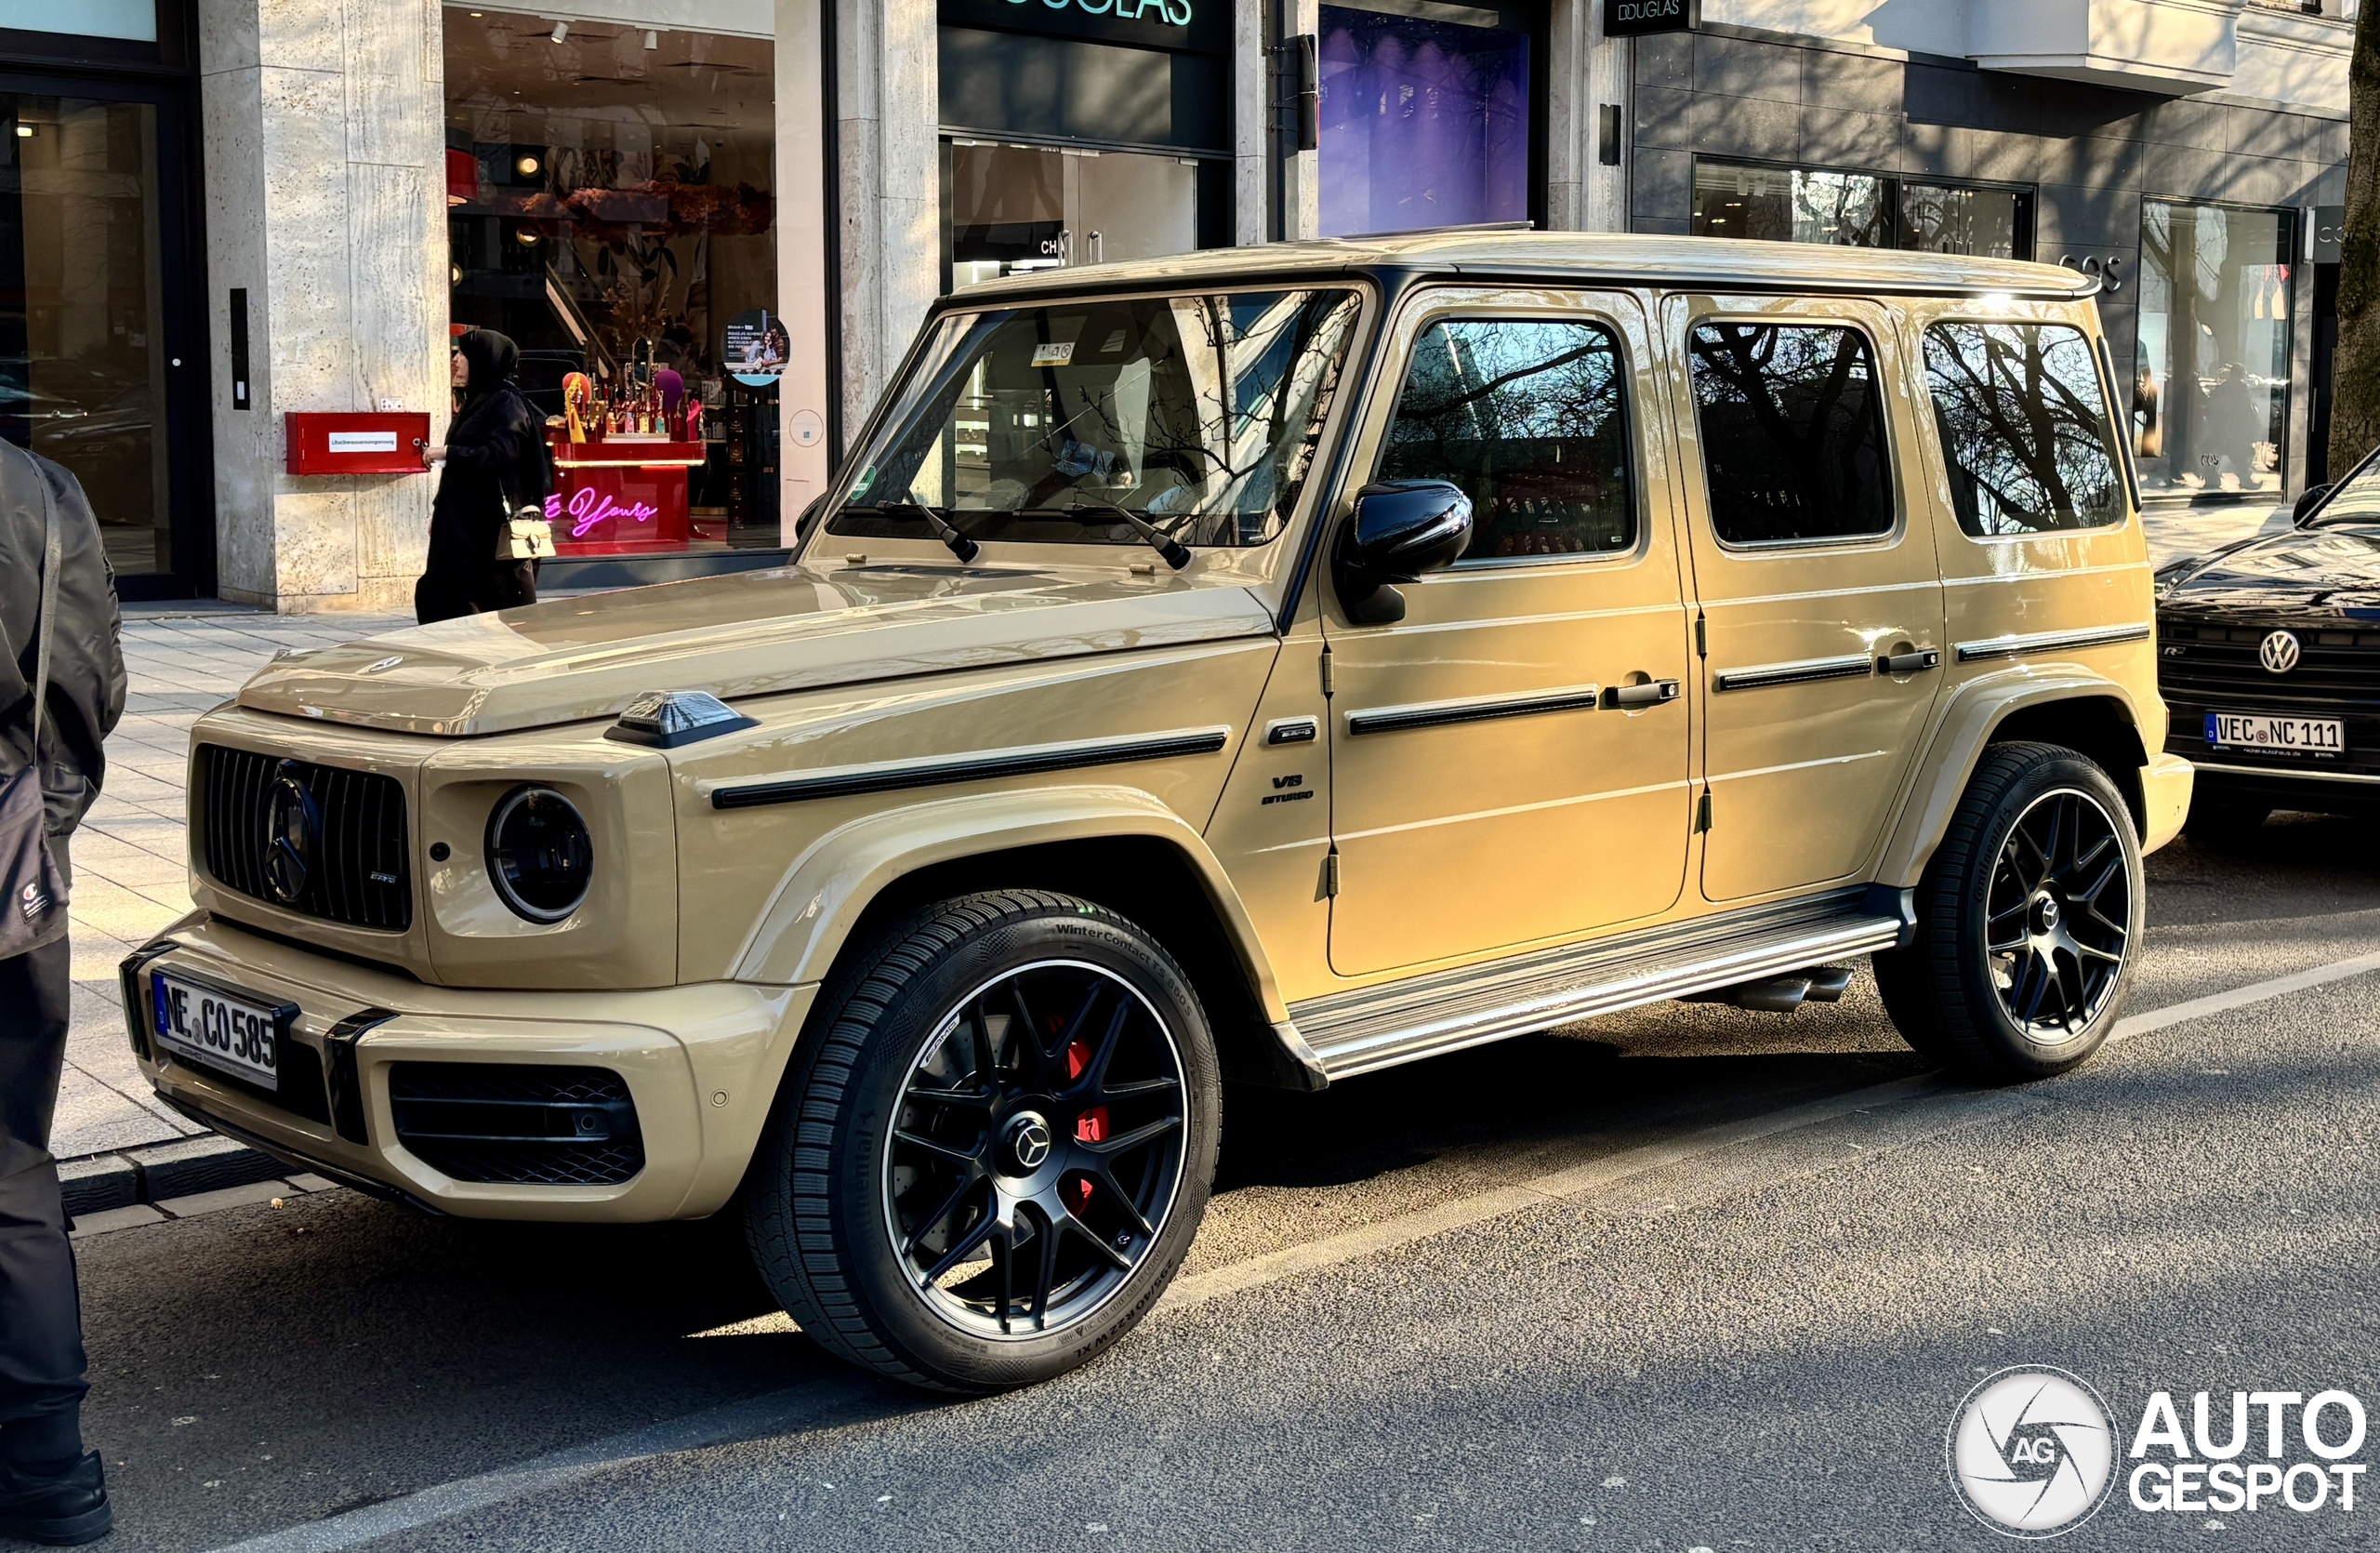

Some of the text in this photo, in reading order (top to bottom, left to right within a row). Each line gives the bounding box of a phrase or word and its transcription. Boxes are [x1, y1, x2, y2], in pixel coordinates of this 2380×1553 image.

[1619, 0, 1679, 20] DOUGLAS
[568, 486, 658, 538] Yours
[2217, 716, 2254, 742] VEC
[2269, 720, 2295, 745] NC
[2300, 722, 2339, 748] 111
[1273, 774, 1302, 789] V8
[165, 983, 192, 1039] NE
[201, 997, 231, 1052] CO
[231, 1008, 276, 1069] 585
[1073, 1342, 1092, 1359] XL
